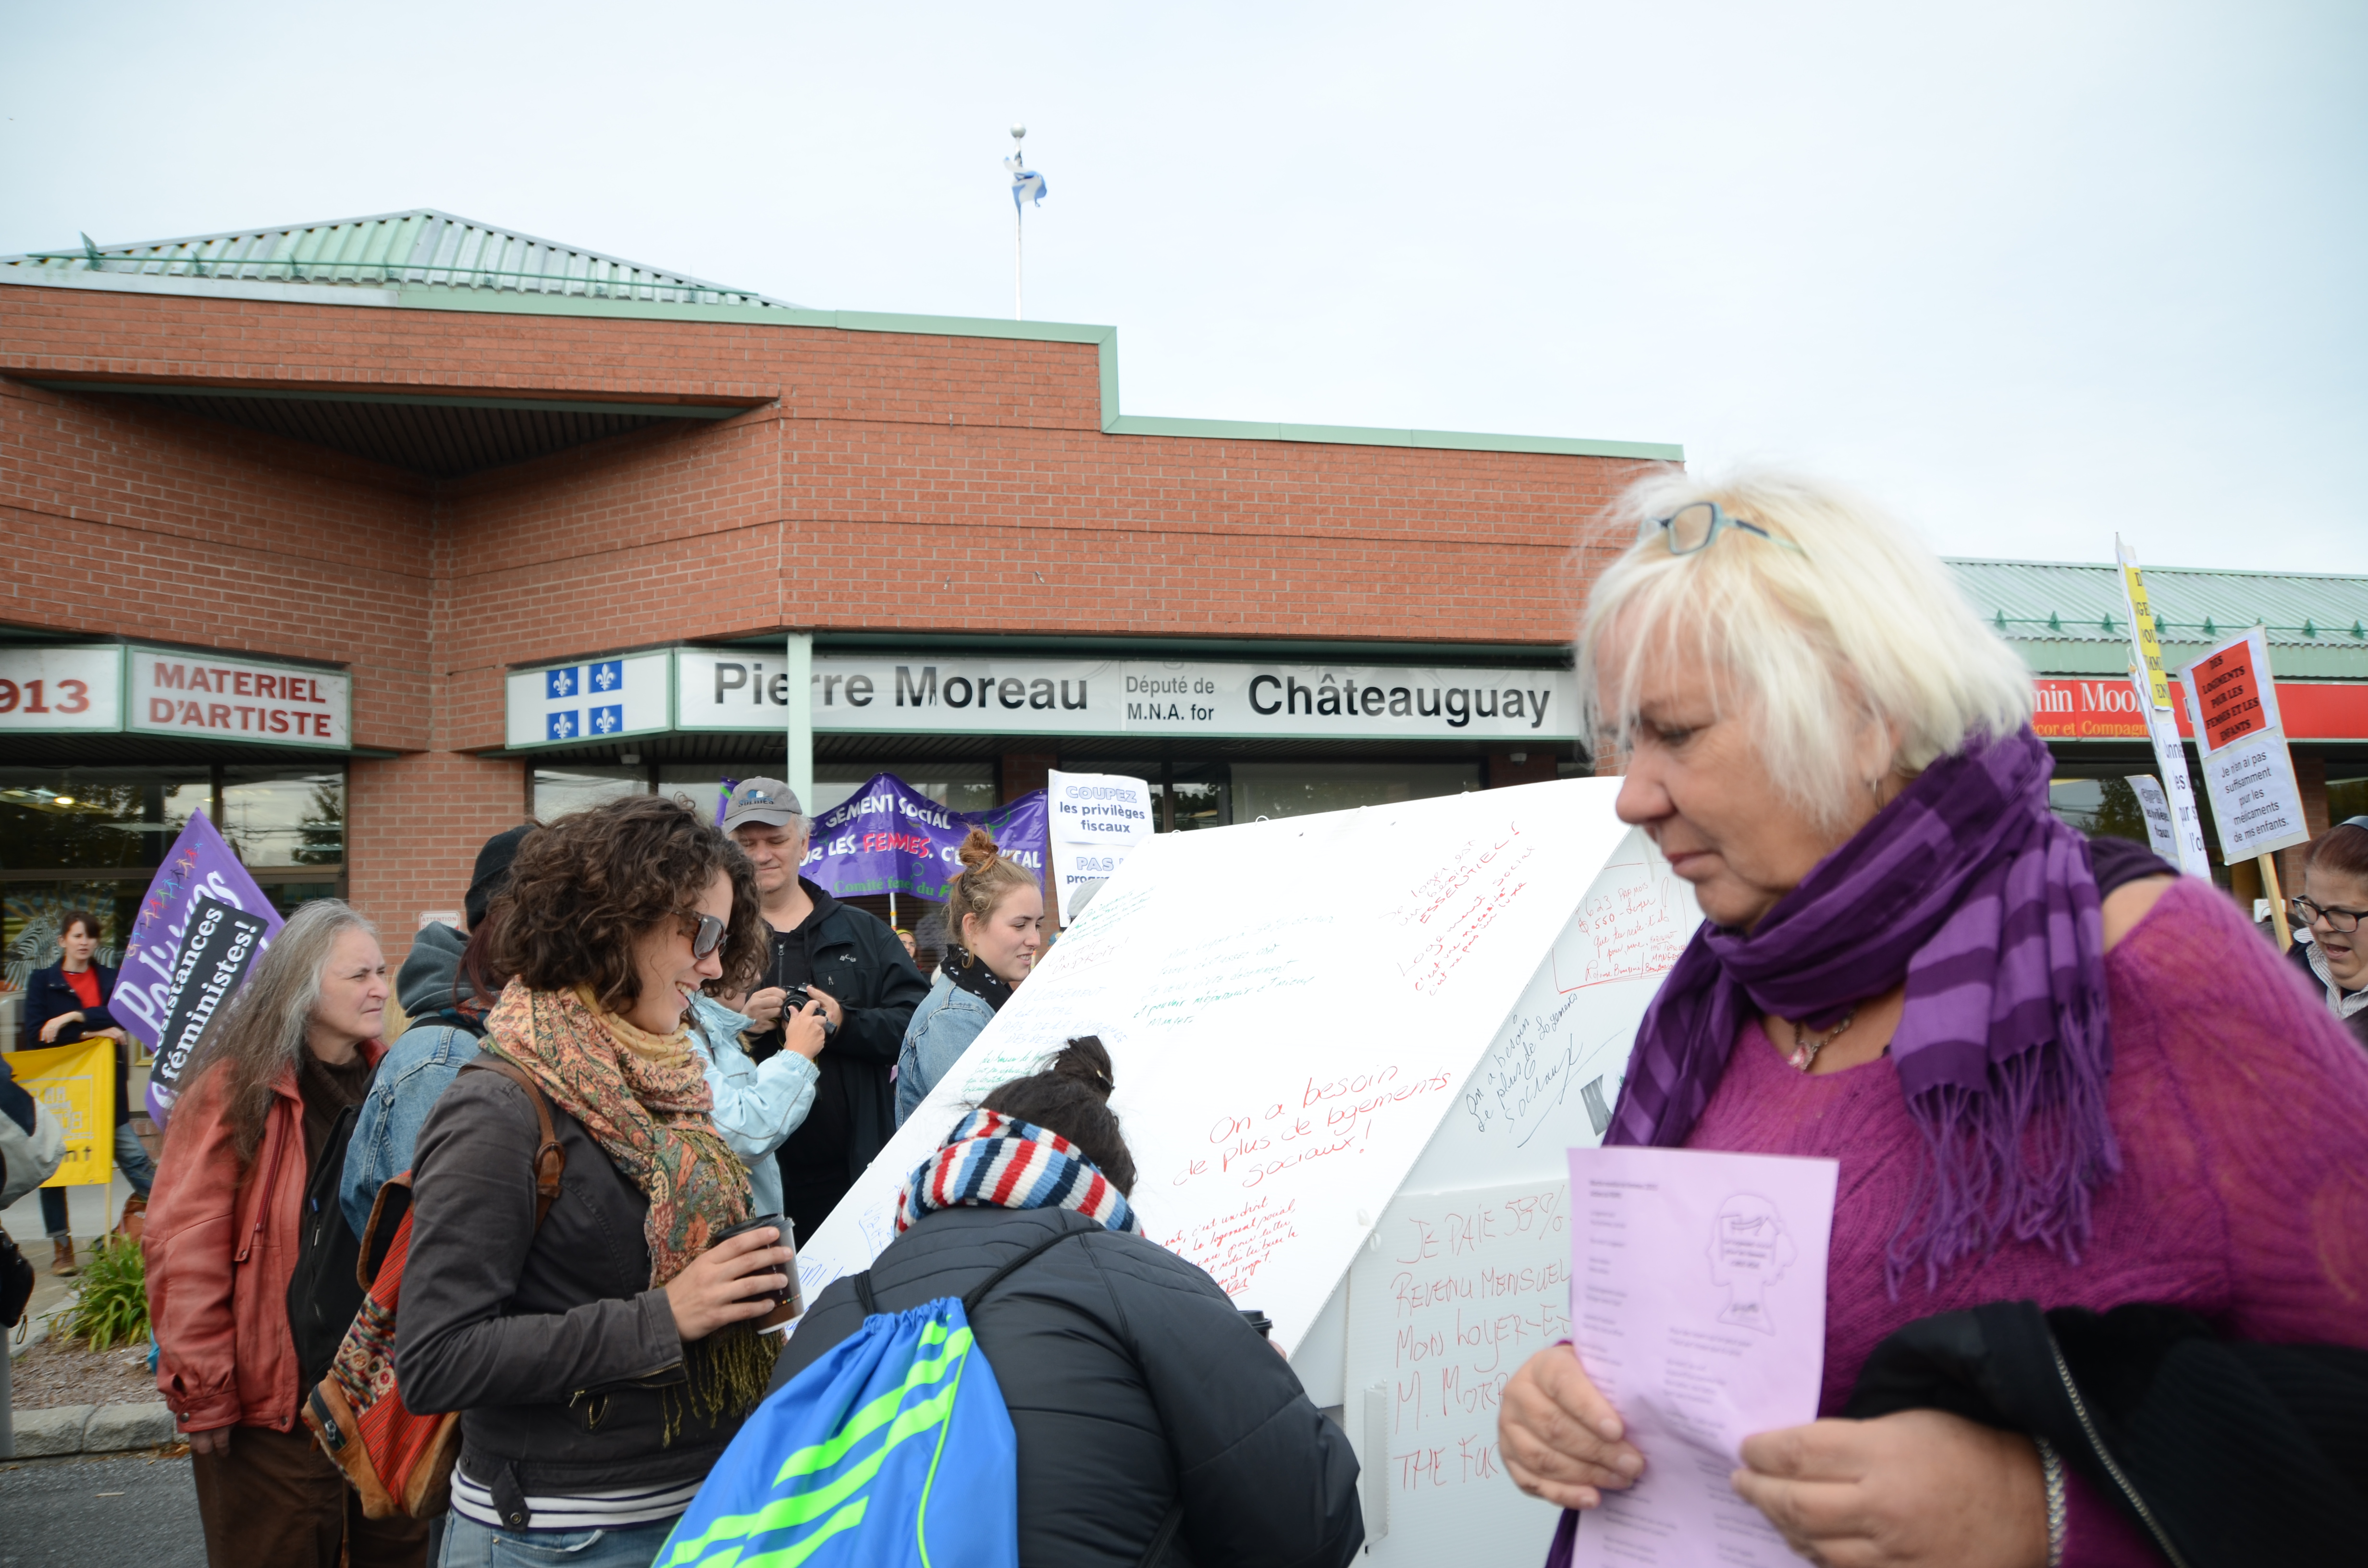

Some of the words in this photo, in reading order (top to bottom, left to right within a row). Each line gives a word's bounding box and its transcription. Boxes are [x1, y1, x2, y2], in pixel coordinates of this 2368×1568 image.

[154, 662, 326, 704] MATERIEL
[895, 666, 1088, 710] Moreau
[1125, 675, 1188, 698] Député
[1193, 677, 1214, 695] de
[2227, 685, 2244, 700] LES
[0, 679, 90, 714] 913
[1249, 673, 1551, 728] Châteauguay
[2231, 704, 2242, 716] ET
[2242, 697, 2260, 711] LES
[149, 698, 331, 738] D'ARTISTE
[1127, 702, 1184, 720] M.N.A.
[1190, 704, 1214, 721] for
[2221, 767, 2230, 778] Je
[2243, 755, 2250, 768] ai
[2252, 752, 2267, 767] pas
[1065, 786, 1137, 803] COUPEZ
[2251, 789, 2264, 800] les
[898, 797, 951, 830] SOCIAL
[1060, 801, 1078, 814] les
[1082, 804, 1145, 820] privilèges
[1080, 820, 1131, 833] fiscaux
[2234, 831, 2243, 843] de
[828, 834, 856, 856] LES
[1076, 857, 1114, 871] PAS
[834, 877, 883, 894] Comité
[916, 882, 934, 896] du
[1595, 913, 1615, 930] 550
[1397, 894, 1486, 977] Logement
[161, 920, 258, 1081] féministes!
[1210, 1117, 1251, 1144] On
[1265, 1103, 1285, 1120] a
[1303, 1065, 1398, 1109] besoin
[1173, 1159, 1208, 1186] de
[1223, 1135, 1270, 1173] plus
[1282, 1117, 1312, 1141] de
[1327, 1066, 1451, 1136] logements
[1240, 1196, 1269, 1217] droit
[1209, 1217, 1256, 1248] logement
[1396, 1217, 1440, 1264] JE
[1391, 1271, 1473, 1318] REVENU
[1393, 1447, 1446, 1491] THE
